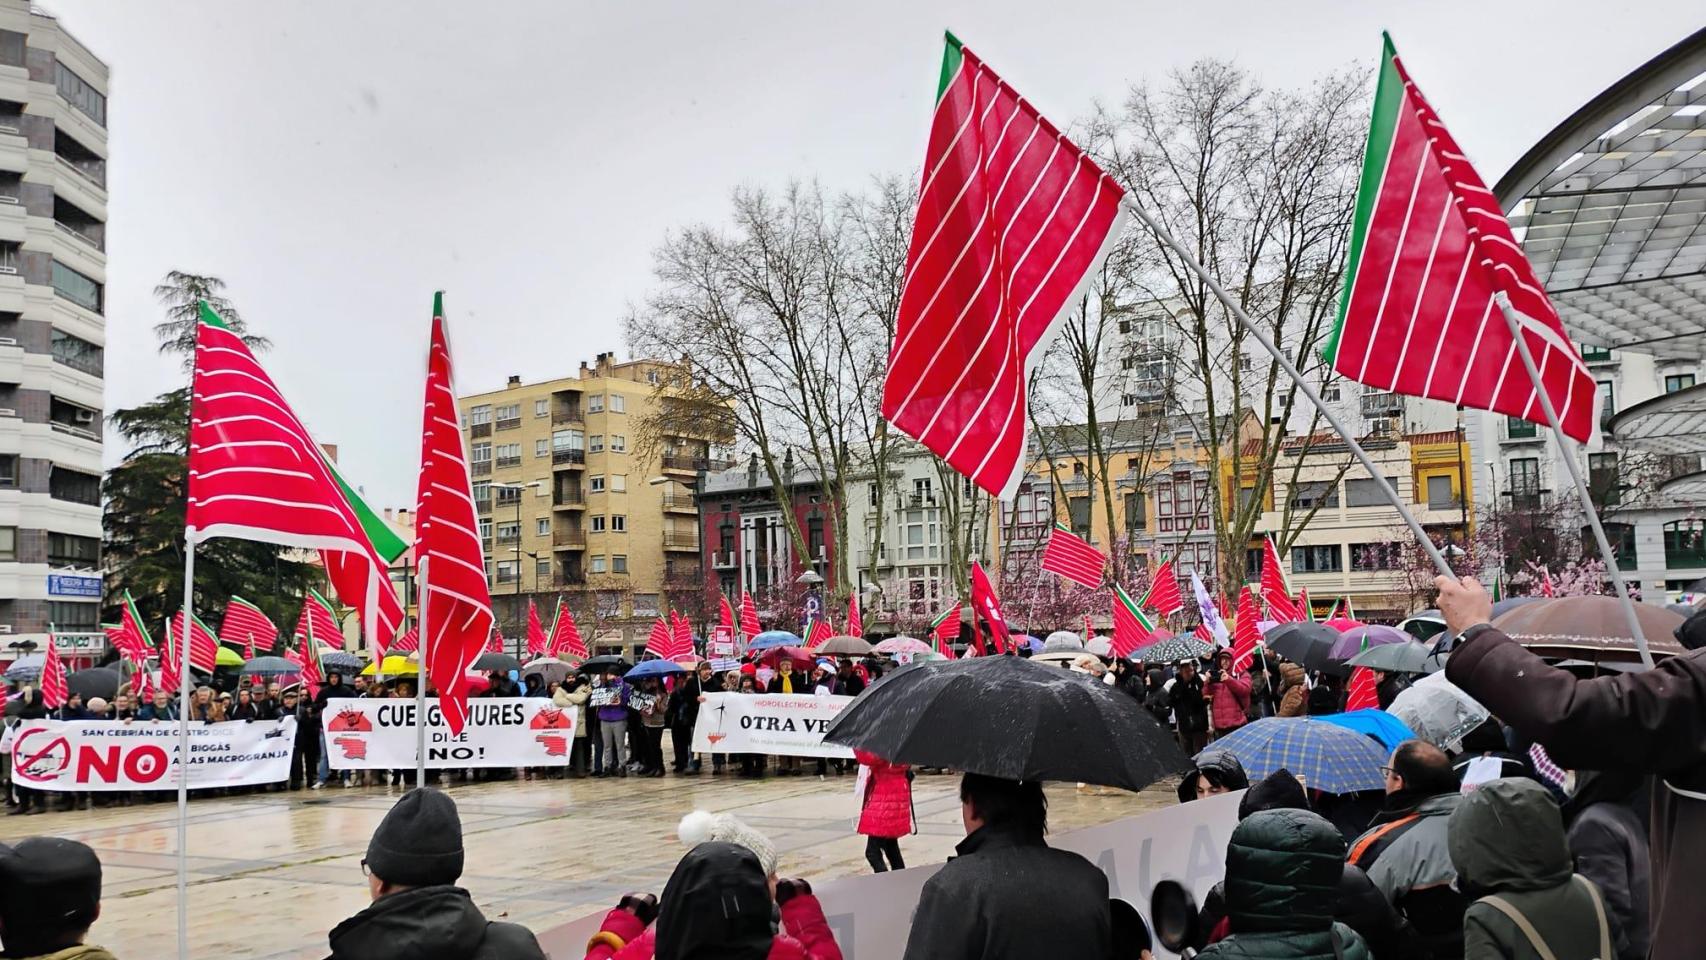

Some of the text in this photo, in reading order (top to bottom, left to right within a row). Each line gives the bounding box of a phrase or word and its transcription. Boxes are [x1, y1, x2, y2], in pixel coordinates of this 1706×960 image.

[377, 704, 525, 727] CUEGURES
[740, 715, 797, 732] OTRA
[82, 729, 104, 737] SAN
[155, 729, 170, 737] DE
[172, 729, 210, 737] CSTRO
[76, 744, 168, 784] NO
[172, 750, 289, 765] A AS MACROGRANJA
